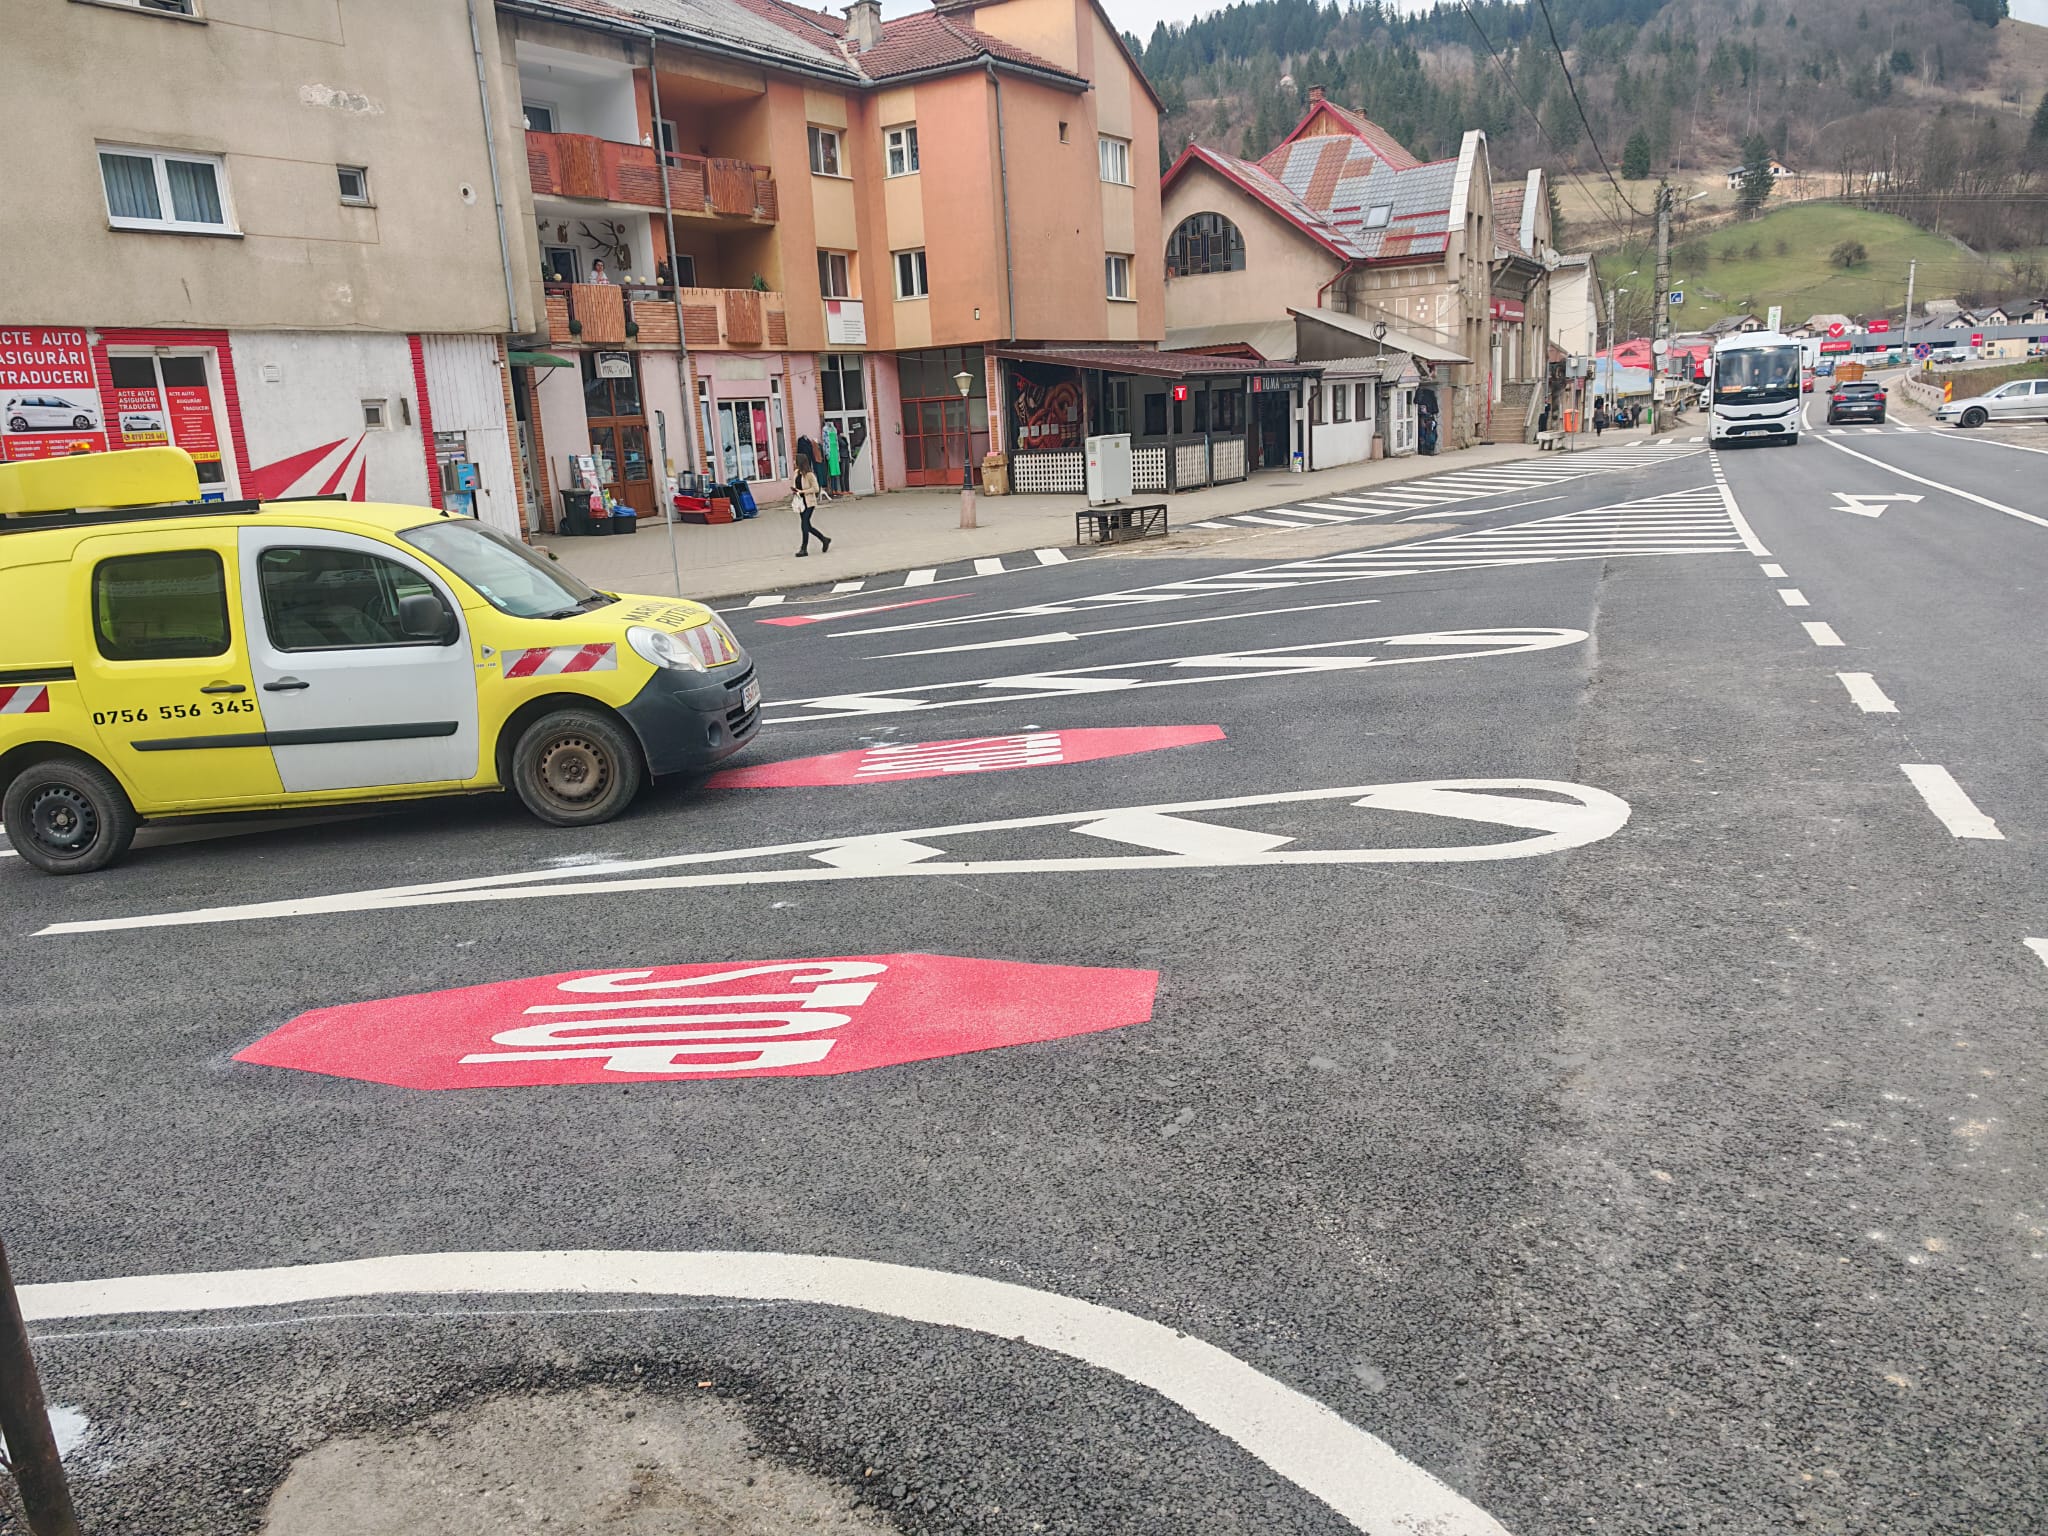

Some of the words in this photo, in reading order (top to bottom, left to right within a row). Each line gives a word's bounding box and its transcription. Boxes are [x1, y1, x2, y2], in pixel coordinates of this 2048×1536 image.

[0, 332, 32, 345] CTE
[42, 332, 82, 346] AUTO
[0, 371, 89, 385] TRADUCERI
[1262, 377, 1280, 390] TOMA
[1175, 387, 1186, 399] T
[93, 709, 148, 725] 0756
[159, 704, 201, 720] 556
[211, 699, 255, 715] 345
[853, 733, 1064, 778] STOP
[457, 961, 889, 1074] STOP
